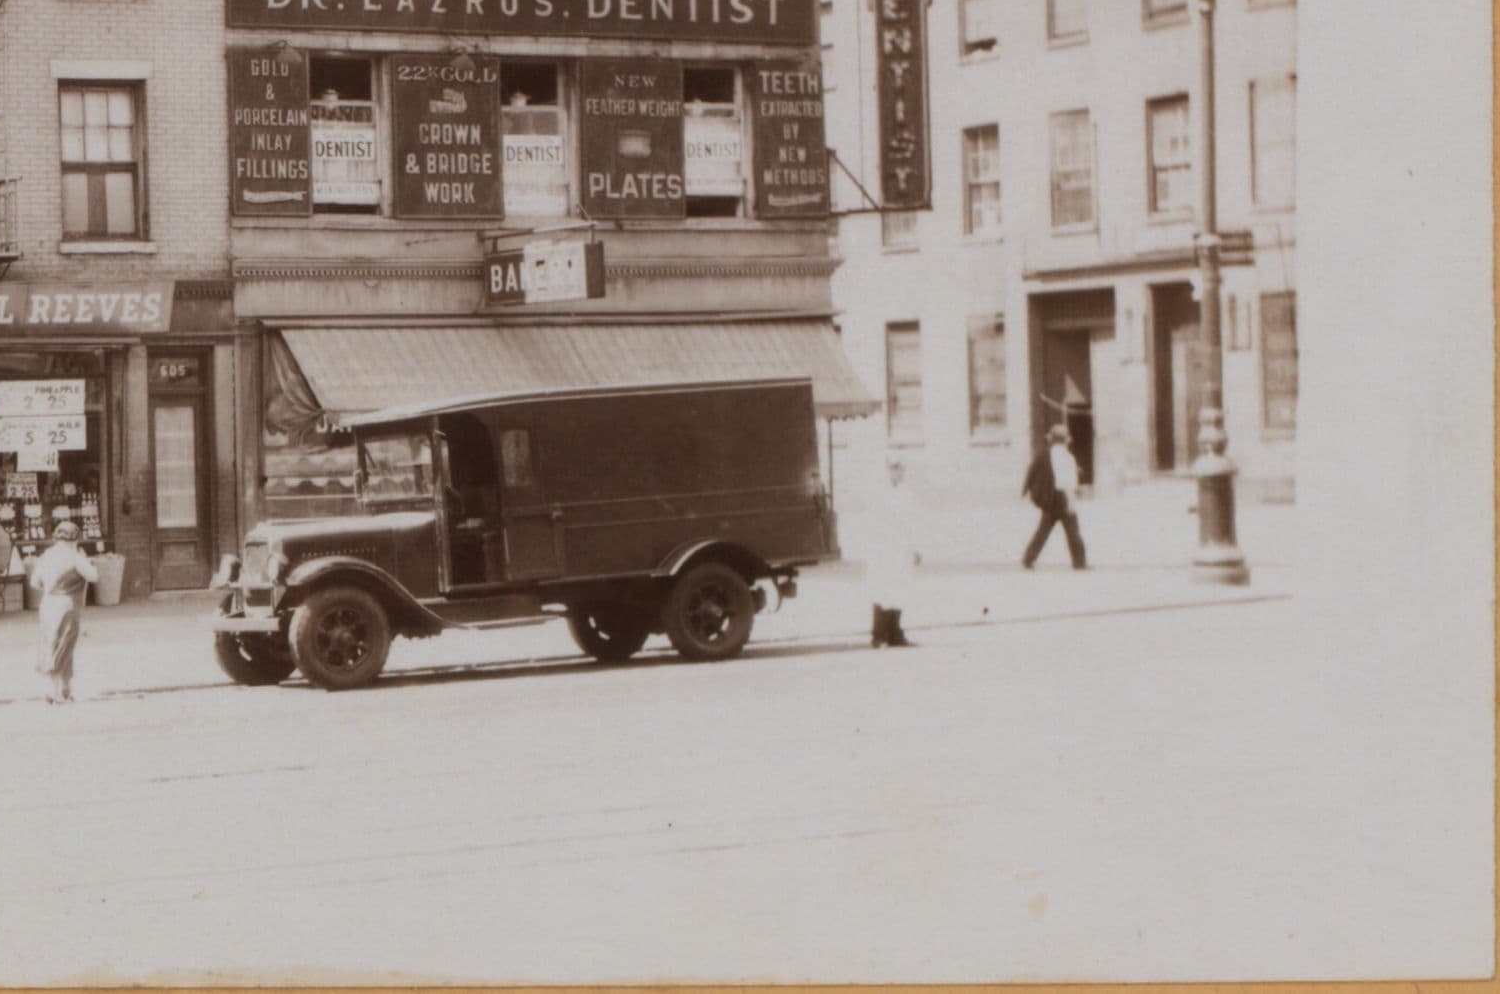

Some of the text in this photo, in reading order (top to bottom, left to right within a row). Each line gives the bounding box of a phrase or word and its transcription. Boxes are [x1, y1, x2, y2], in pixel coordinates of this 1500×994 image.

[251, 59, 289, 77] GOLD
[440, 67, 497, 84] GOLD
[614, 75, 657, 88] NEW
[759, 70, 819, 94] TEETH
[265, 83, 275, 100] &
[586, 98, 681, 117] FEATHER WEIGHT
[760, 100, 822, 118] EXTRACTED
[234, 108, 308, 127] PORCELAIN
[419, 123, 481, 145] CROWN
[783, 123, 799, 140] BY
[251, 133, 292, 151] INLAY
[315, 141, 372, 158] DENTIST
[687, 141, 740, 159] DENTIST
[505, 145, 562, 163] DENTIST
[779, 146, 807, 163] NEW
[236, 158, 309, 180] FILLINGS
[405, 153, 492, 175] & BRIDGE
[588, 172, 683, 199] PLATES
[763, 168, 824, 185] METHODS
[424, 182, 476, 204] WORK
[28, 292, 163, 324] REEVES
[159, 364, 186, 377] 605
[24, 430, 68, 446] 5 25
